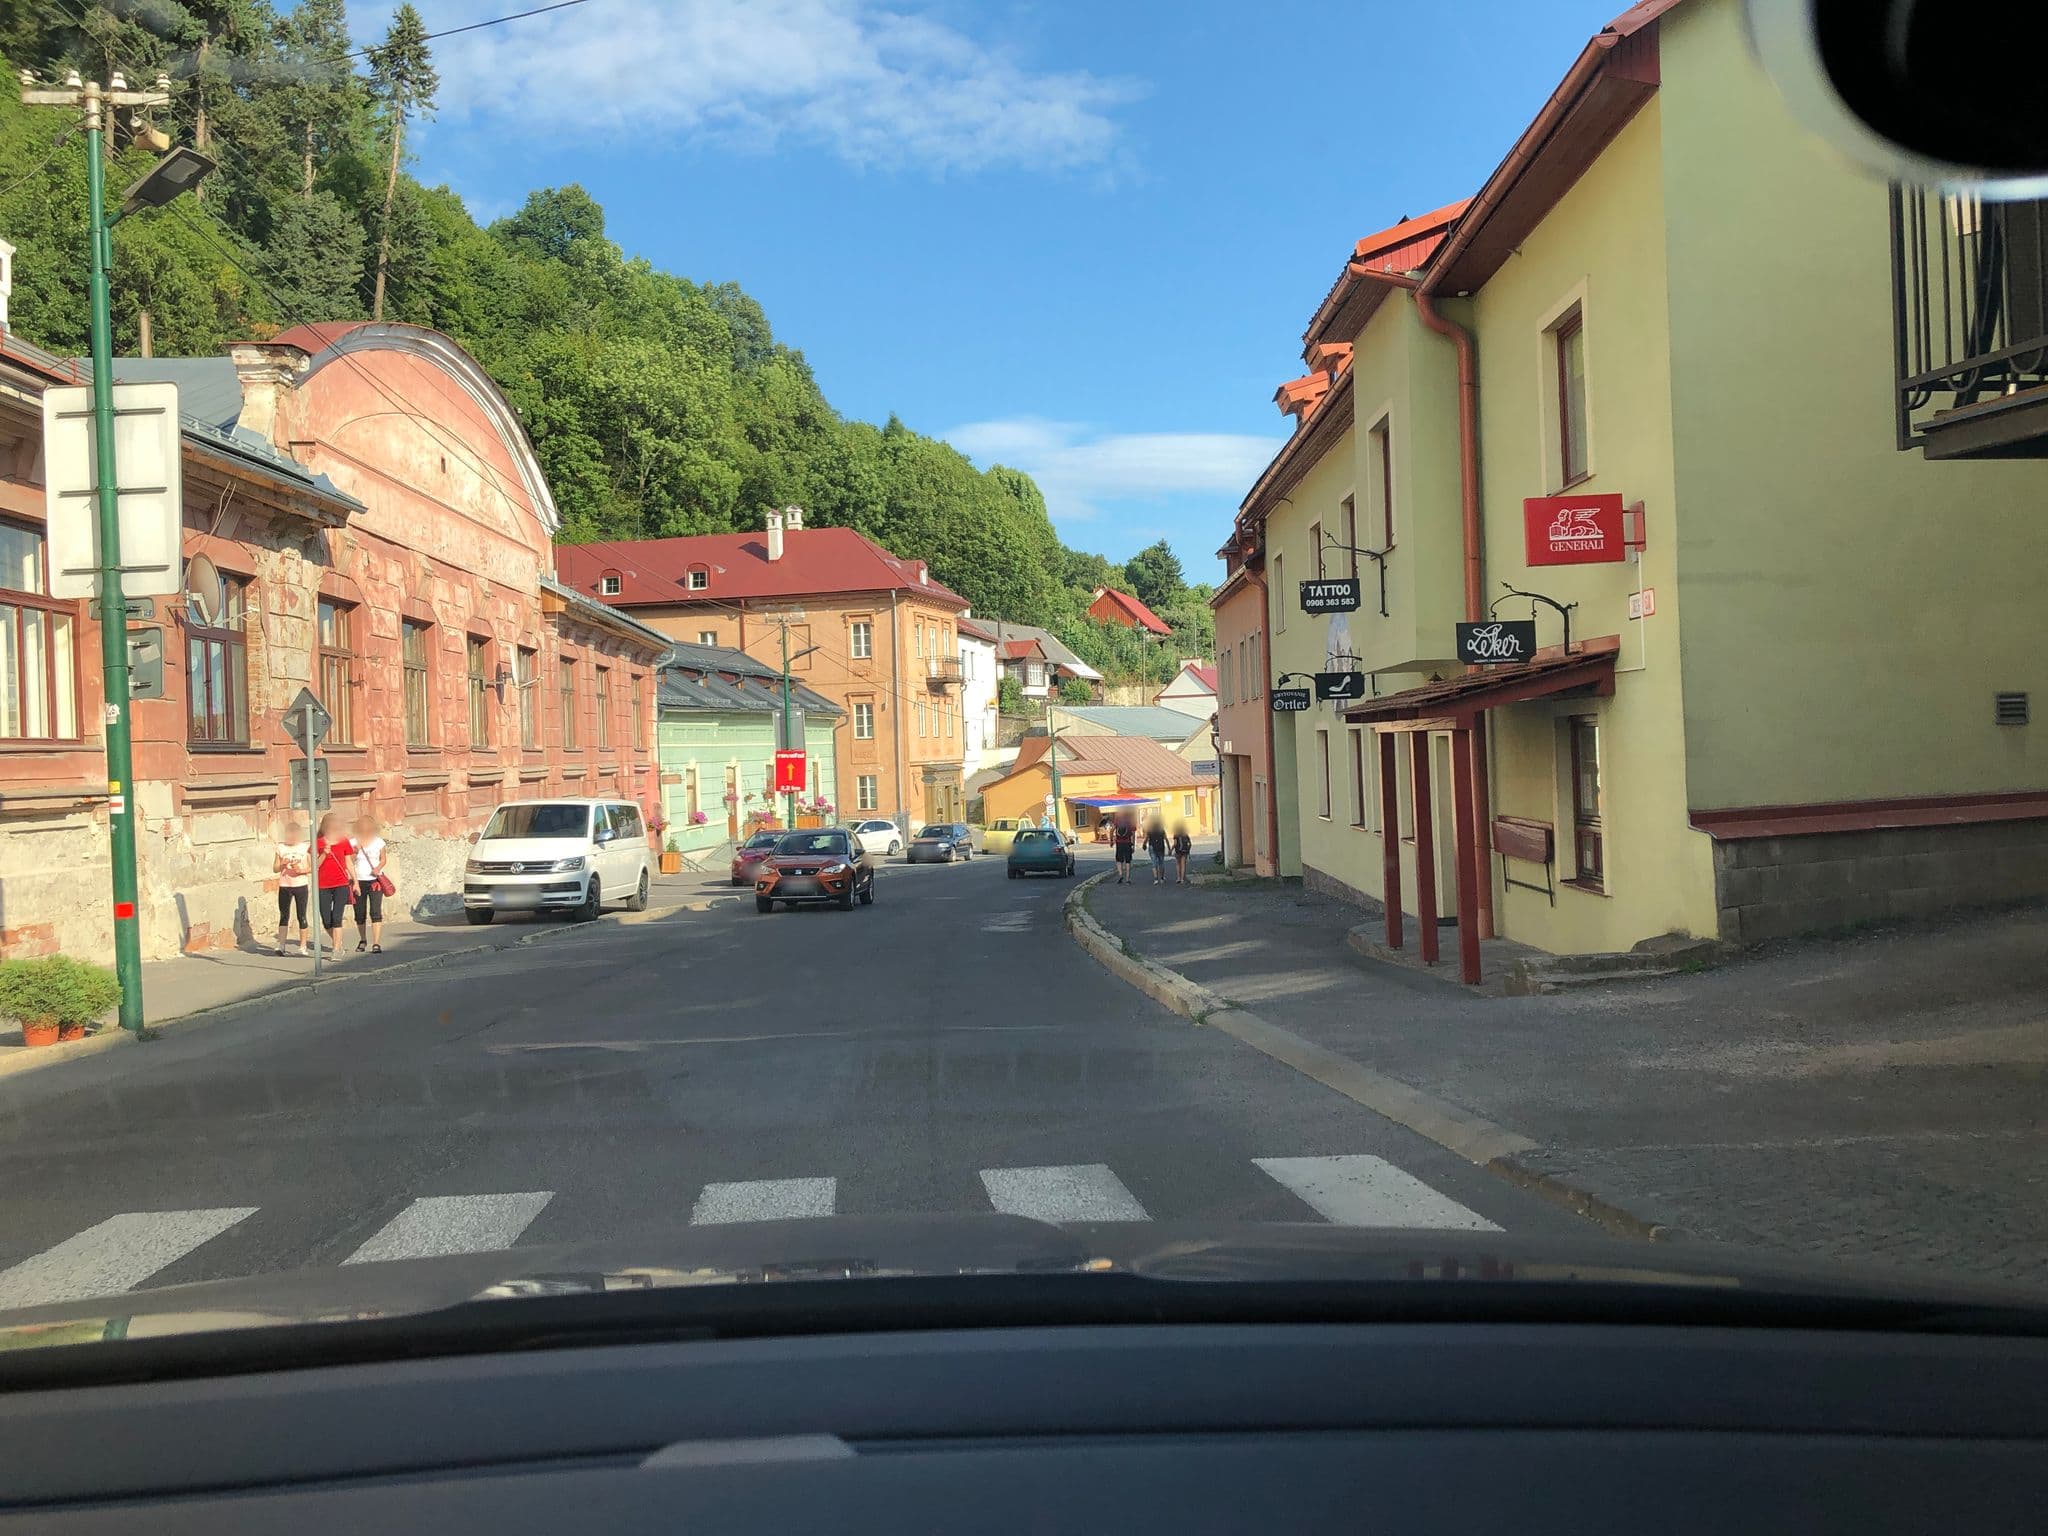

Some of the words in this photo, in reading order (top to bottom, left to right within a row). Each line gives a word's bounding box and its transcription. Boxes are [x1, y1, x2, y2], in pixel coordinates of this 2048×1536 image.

[1550, 540, 1604, 552] GENERALI
[1308, 584, 1351, 597] TATTOO
[1306, 599, 1324, 607] 0908
[1273, 699, 1307, 711] Ortler
